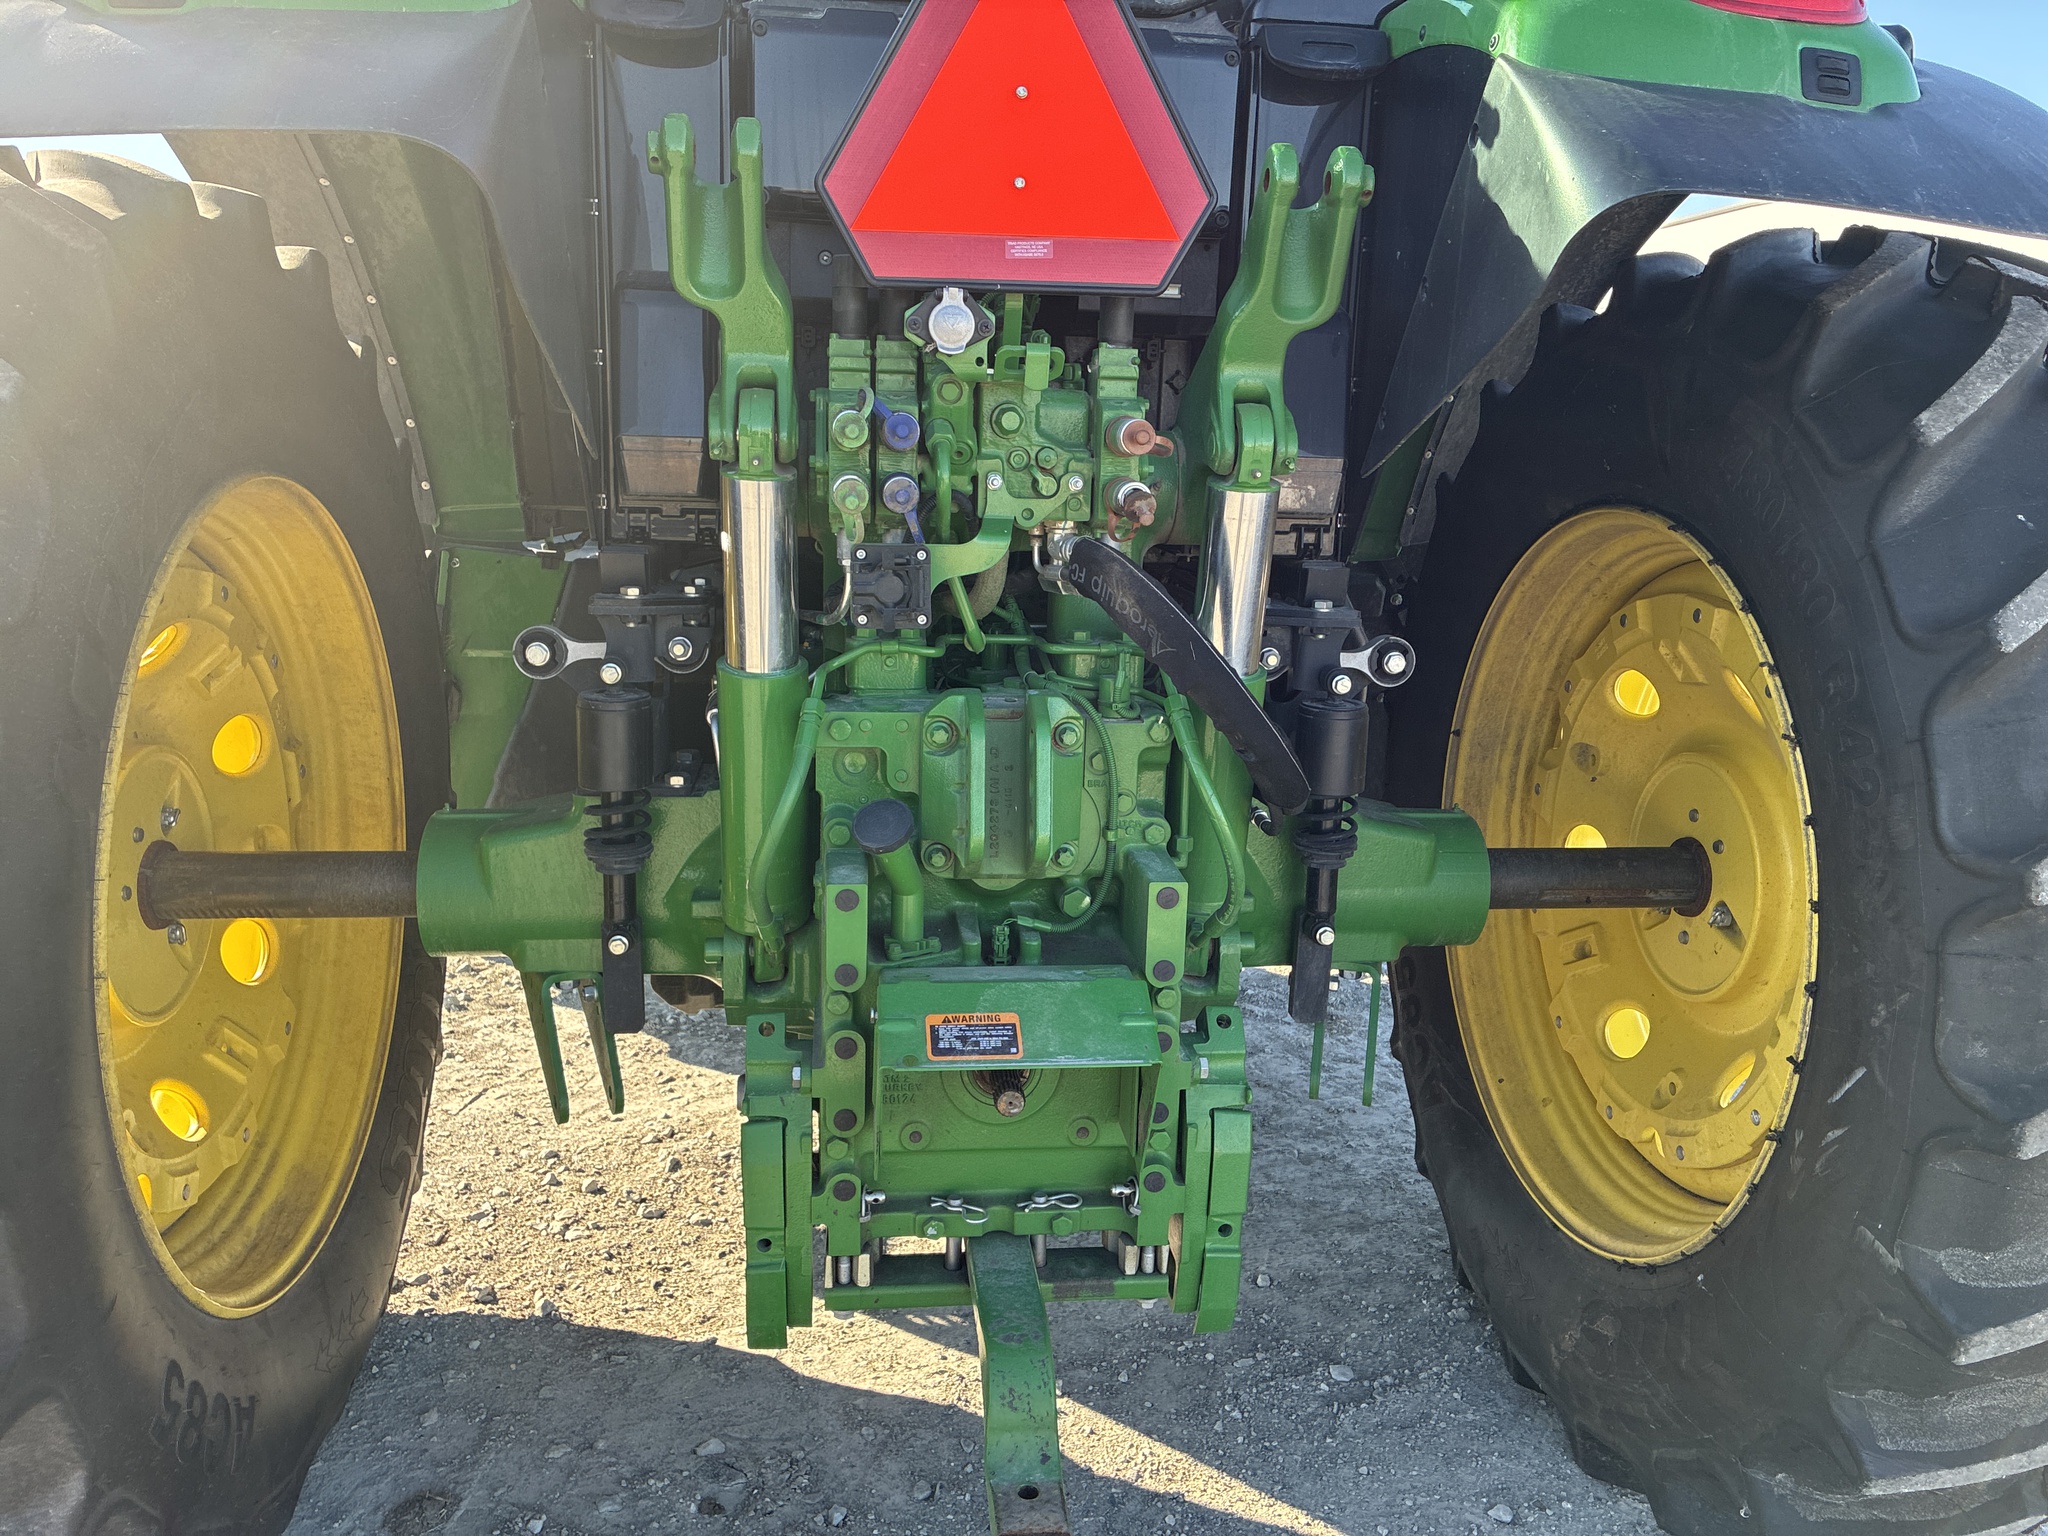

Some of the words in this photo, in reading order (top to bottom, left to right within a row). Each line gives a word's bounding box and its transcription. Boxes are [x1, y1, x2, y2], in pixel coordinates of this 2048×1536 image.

[1069, 563, 1086, 583] FC
[1091, 574, 1177, 658] Aeroquip
[951, 1014, 1001, 1023] WARNING
[884, 1082, 923, 1092] URKEY
